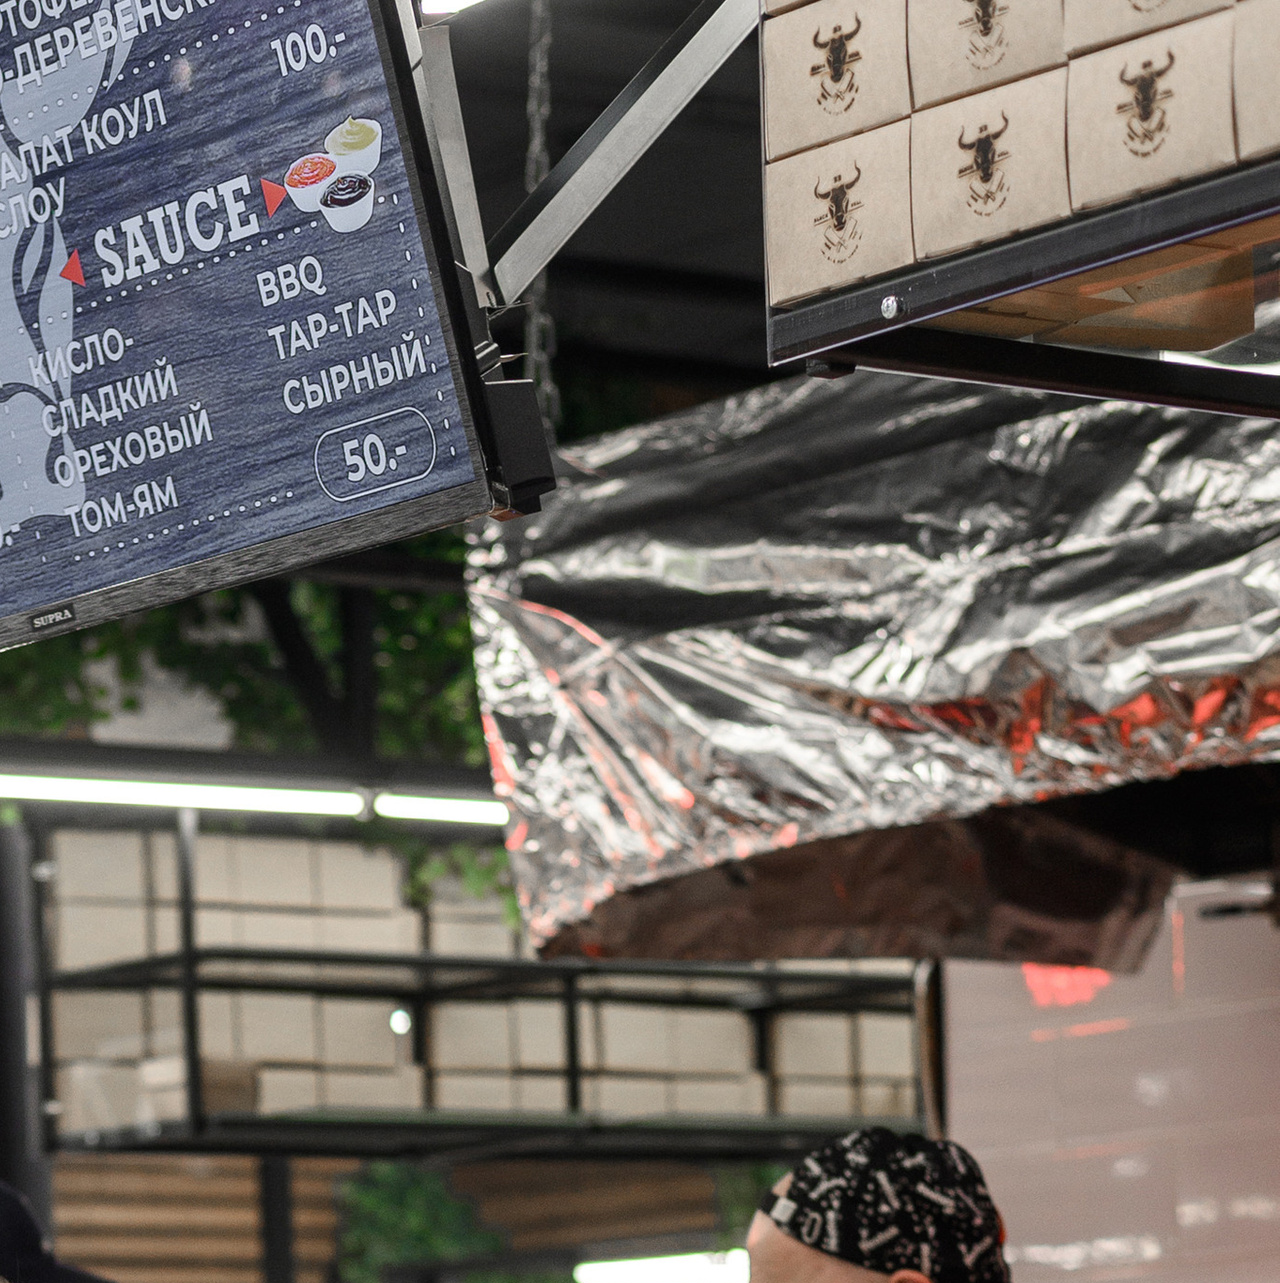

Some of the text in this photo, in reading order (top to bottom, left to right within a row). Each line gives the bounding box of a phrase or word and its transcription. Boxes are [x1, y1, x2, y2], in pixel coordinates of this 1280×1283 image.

[81, 88, 168, 155] КОУЛ
[94, 175, 260, 289] SAUCE
[256, 254, 327, 308] BBQ
[28, 327, 135, 388] КИСЛО-
[267, 289, 398, 361] ТАР-ТАР
[41, 357, 179, 441] СЛАДКИЙ
[283, 334, 428, 415] СЫРНЫЙ
[54, 402, 214, 489] ОРЕХОВЫЙ
[63, 475, 179, 538] ТОМ-ЯМ
[32, 609, 72, 628] SUPRA
